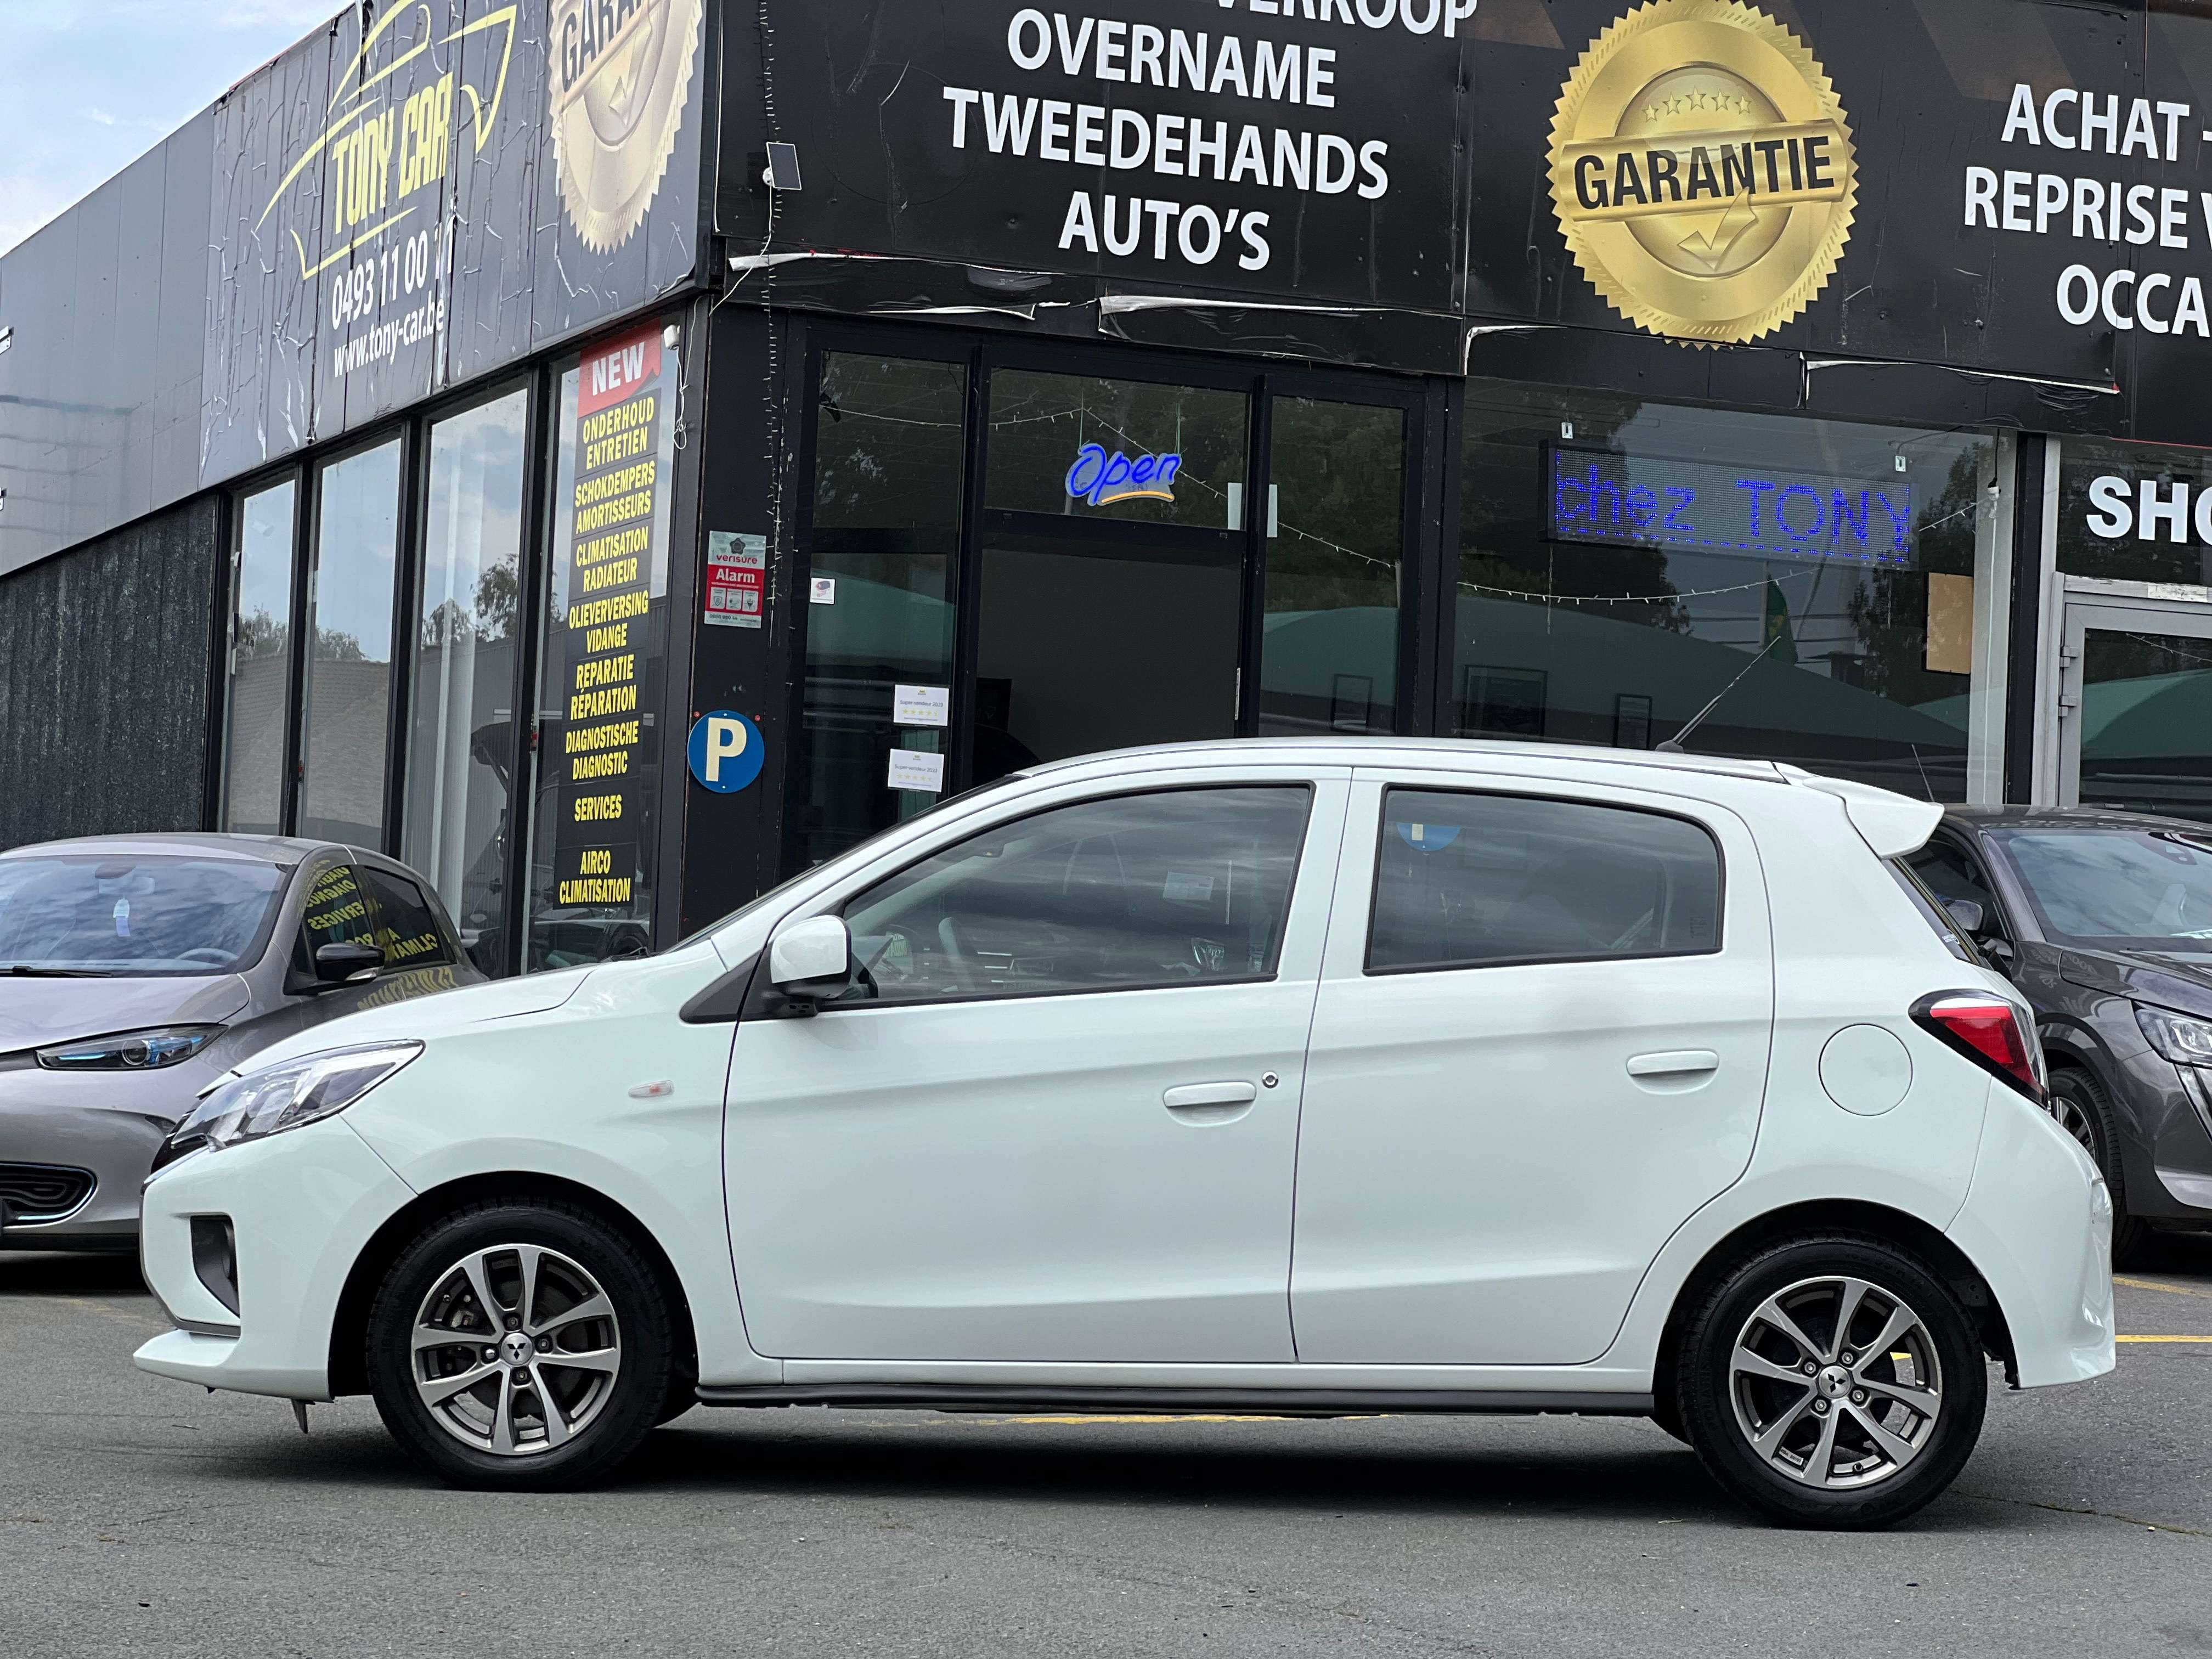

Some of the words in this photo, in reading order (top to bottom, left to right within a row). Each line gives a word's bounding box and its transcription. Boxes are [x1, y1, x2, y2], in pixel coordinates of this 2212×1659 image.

[1008, 8, 1336, 108] OVERNAME
[943, 86, 1389, 199] TWEEDEHANDS
[2001, 83, 2190, 161] ACHAT
[332, 106, 394, 234] TONY
[398, 72, 453, 199] CAR
[1574, 136, 1834, 210] GARANTIE
[1058, 191, 1270, 270] AUTO'S
[1965, 166, 2188, 249] REPRISE
[332, 258, 375, 330] 0493
[381, 244, 399, 307] 11
[404, 230, 428, 294] 00
[2056, 264, 2210, 337] OCCA
[334, 290, 445, 377] www.tony-car.be
[592, 342, 645, 396] NEW
[583, 397, 654, 444] ONDERHOUD
[586, 426, 648, 470] ENTRETIEN
[575, 460, 655, 507] SCHOKDEMPERS
[1070, 445, 1180, 504] Open
[1556, 465, 1696, 530] chez
[576, 490, 651, 534] AMORTISSEURS
[577, 526, 648, 567] CLIMATISATION
[716, 554, 758, 564] verisure
[583, 557, 637, 592] RADIATEUR
[715, 568, 755, 583] Alarm
[569, 590, 648, 629] OLIEVERVERSING
[586, 623, 628, 653] VIDANGE
[576, 654, 634, 689] REPARATIE
[571, 685, 636, 720] RÉPARATION
[566, 720, 639, 753] DIAGNOSTISCHE
[706, 717, 747, 782] P
[572, 751, 628, 780] DIAGNOSTIC
[574, 794, 622, 821] SERVICES
[580, 850, 611, 874] AIRCO
[559, 878, 631, 904] CLIMATISATION
